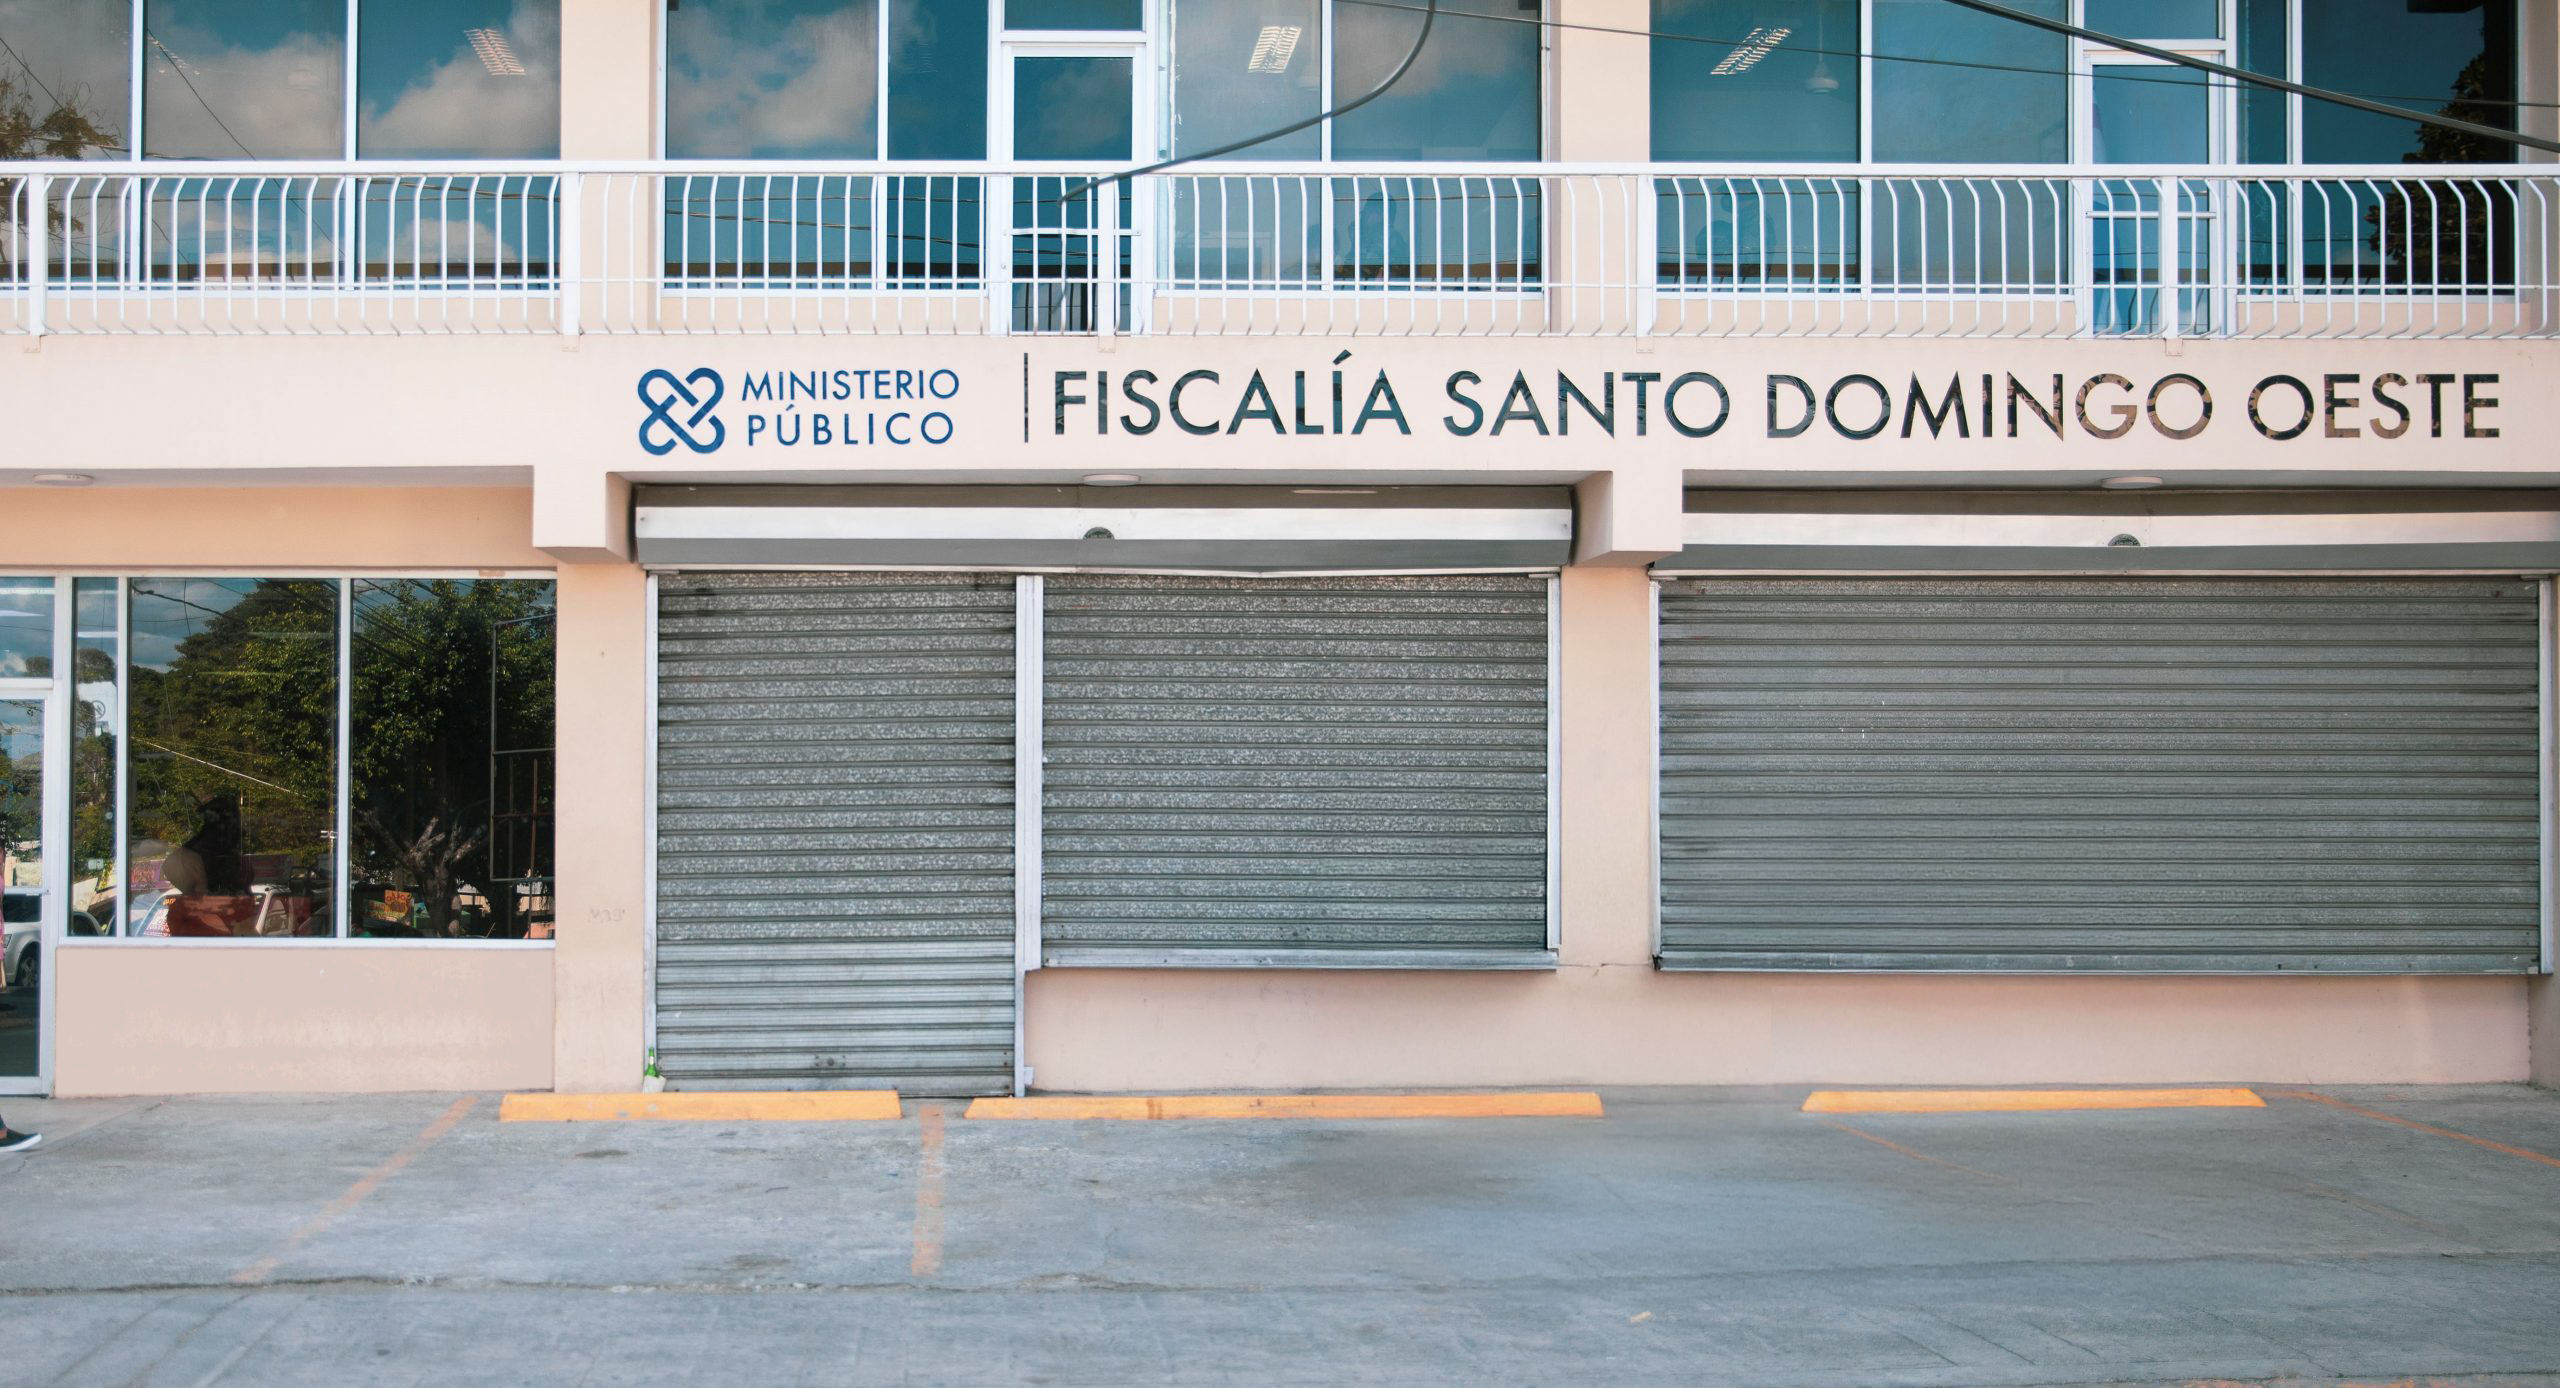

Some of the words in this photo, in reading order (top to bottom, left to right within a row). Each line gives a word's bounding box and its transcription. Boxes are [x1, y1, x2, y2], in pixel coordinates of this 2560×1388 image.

[743, 369, 959, 401] MINISTERIO
[1054, 349, 1412, 436] FISCALÍA
[1443, 368, 1731, 439] SANTO
[1766, 370, 2213, 441] DOMINGO
[2247, 371, 2500, 442] OESTE
[748, 403, 954, 446] PÚBLICO
